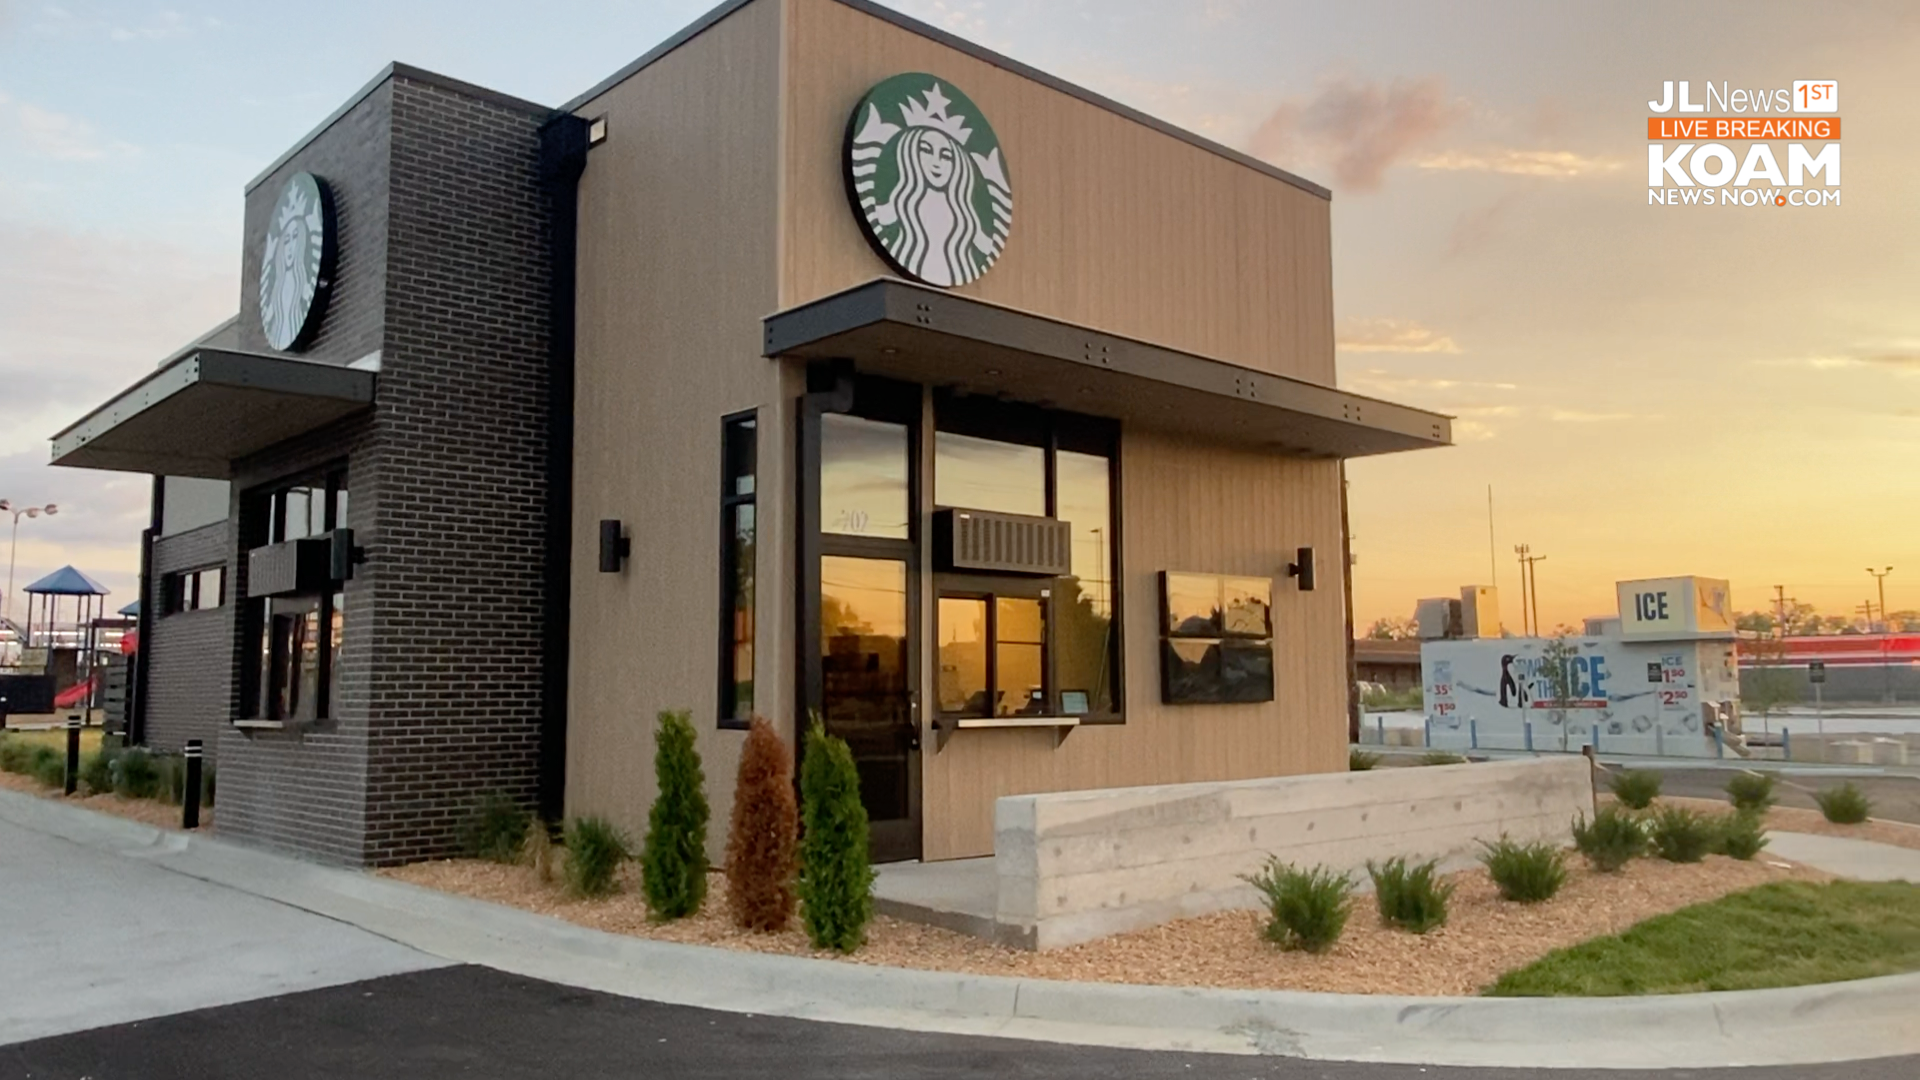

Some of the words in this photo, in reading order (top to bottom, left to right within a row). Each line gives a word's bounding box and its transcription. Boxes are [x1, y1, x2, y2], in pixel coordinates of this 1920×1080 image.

[1635, 591, 1669, 621] ICE
[1661, 656, 1682, 666] ICE
[1559, 655, 1607, 698] ICE
